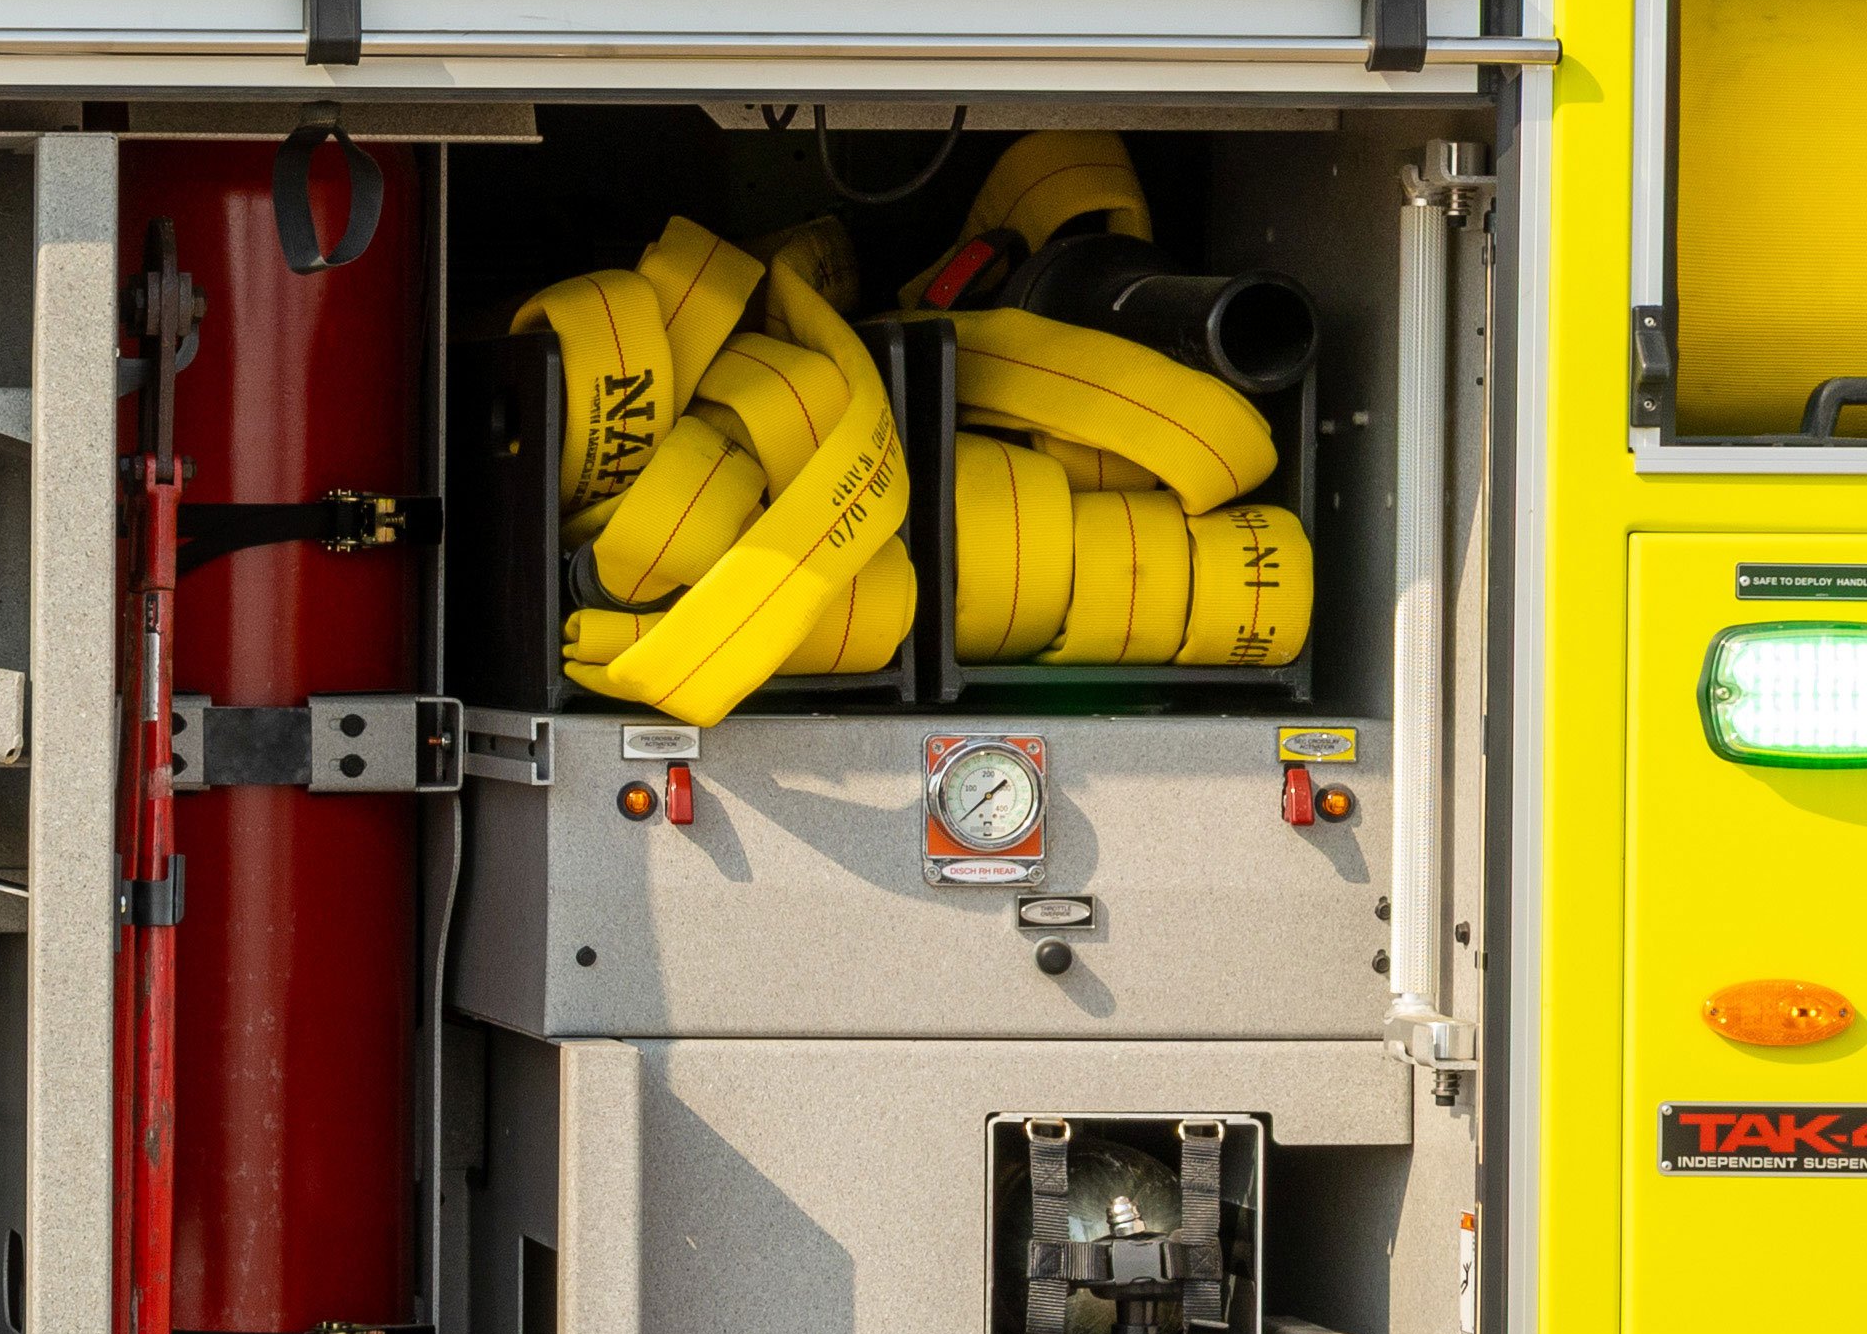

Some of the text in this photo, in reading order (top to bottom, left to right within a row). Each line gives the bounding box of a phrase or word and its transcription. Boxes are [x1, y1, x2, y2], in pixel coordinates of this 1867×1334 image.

[1238, 545, 1281, 588] IN
[1753, 577, 1778, 586] SAFE
[1780, 577, 1793, 586] TO
[1794, 577, 1833, 586] DEPLOY
[982, 770, 995, 778] 200
[965, 784, 977, 792] 100
[949, 867, 1017, 875] DISCH RH REAR
[1678, 1113, 1867, 1154] TAK-
[1678, 1156, 1797, 1168] INDEPENDENT
